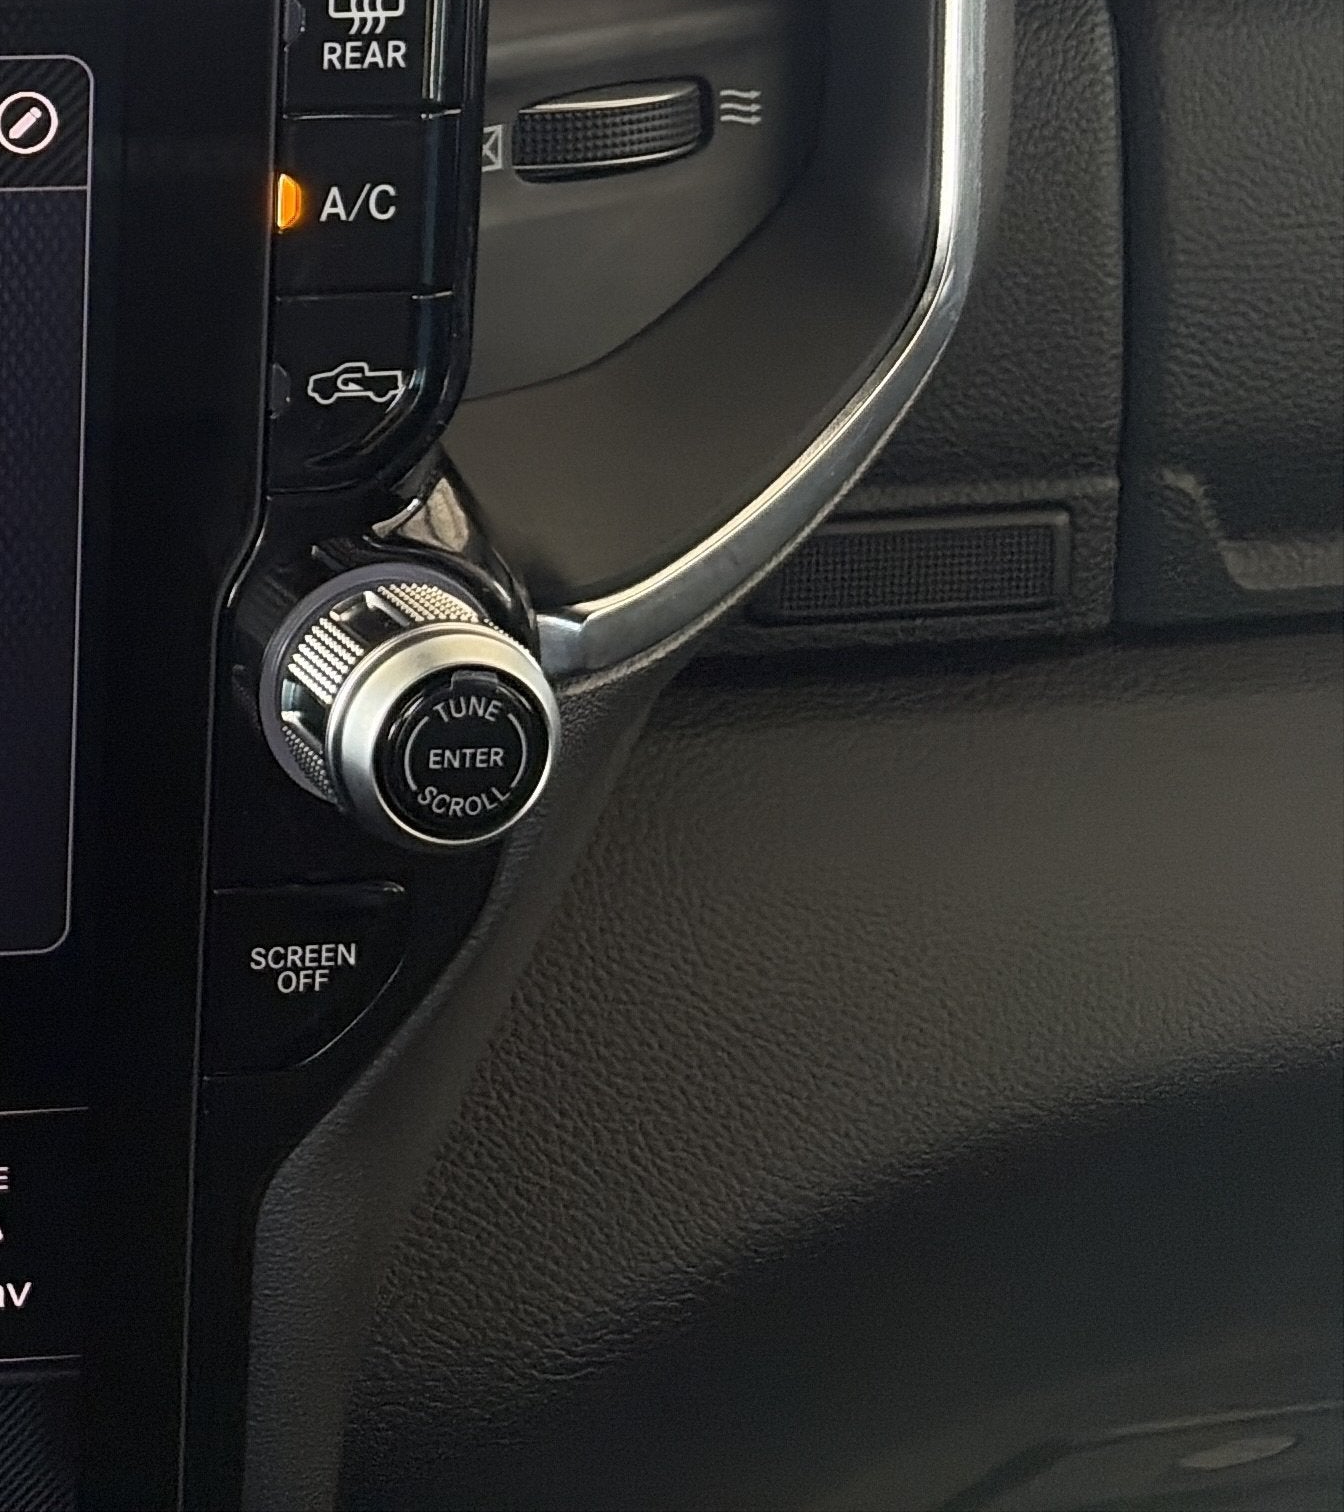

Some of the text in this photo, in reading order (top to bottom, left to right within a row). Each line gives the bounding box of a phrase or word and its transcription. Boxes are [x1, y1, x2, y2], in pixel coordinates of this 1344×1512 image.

[322, 41, 407, 71] REAR
[319, 183, 398, 224] A/C
[433, 695, 504, 725] TUNE
[428, 748, 504, 771] ENTER
[417, 785, 511, 818] SCROLL
[250, 943, 357, 970] SCREEN
[277, 970, 330, 994] OFF
